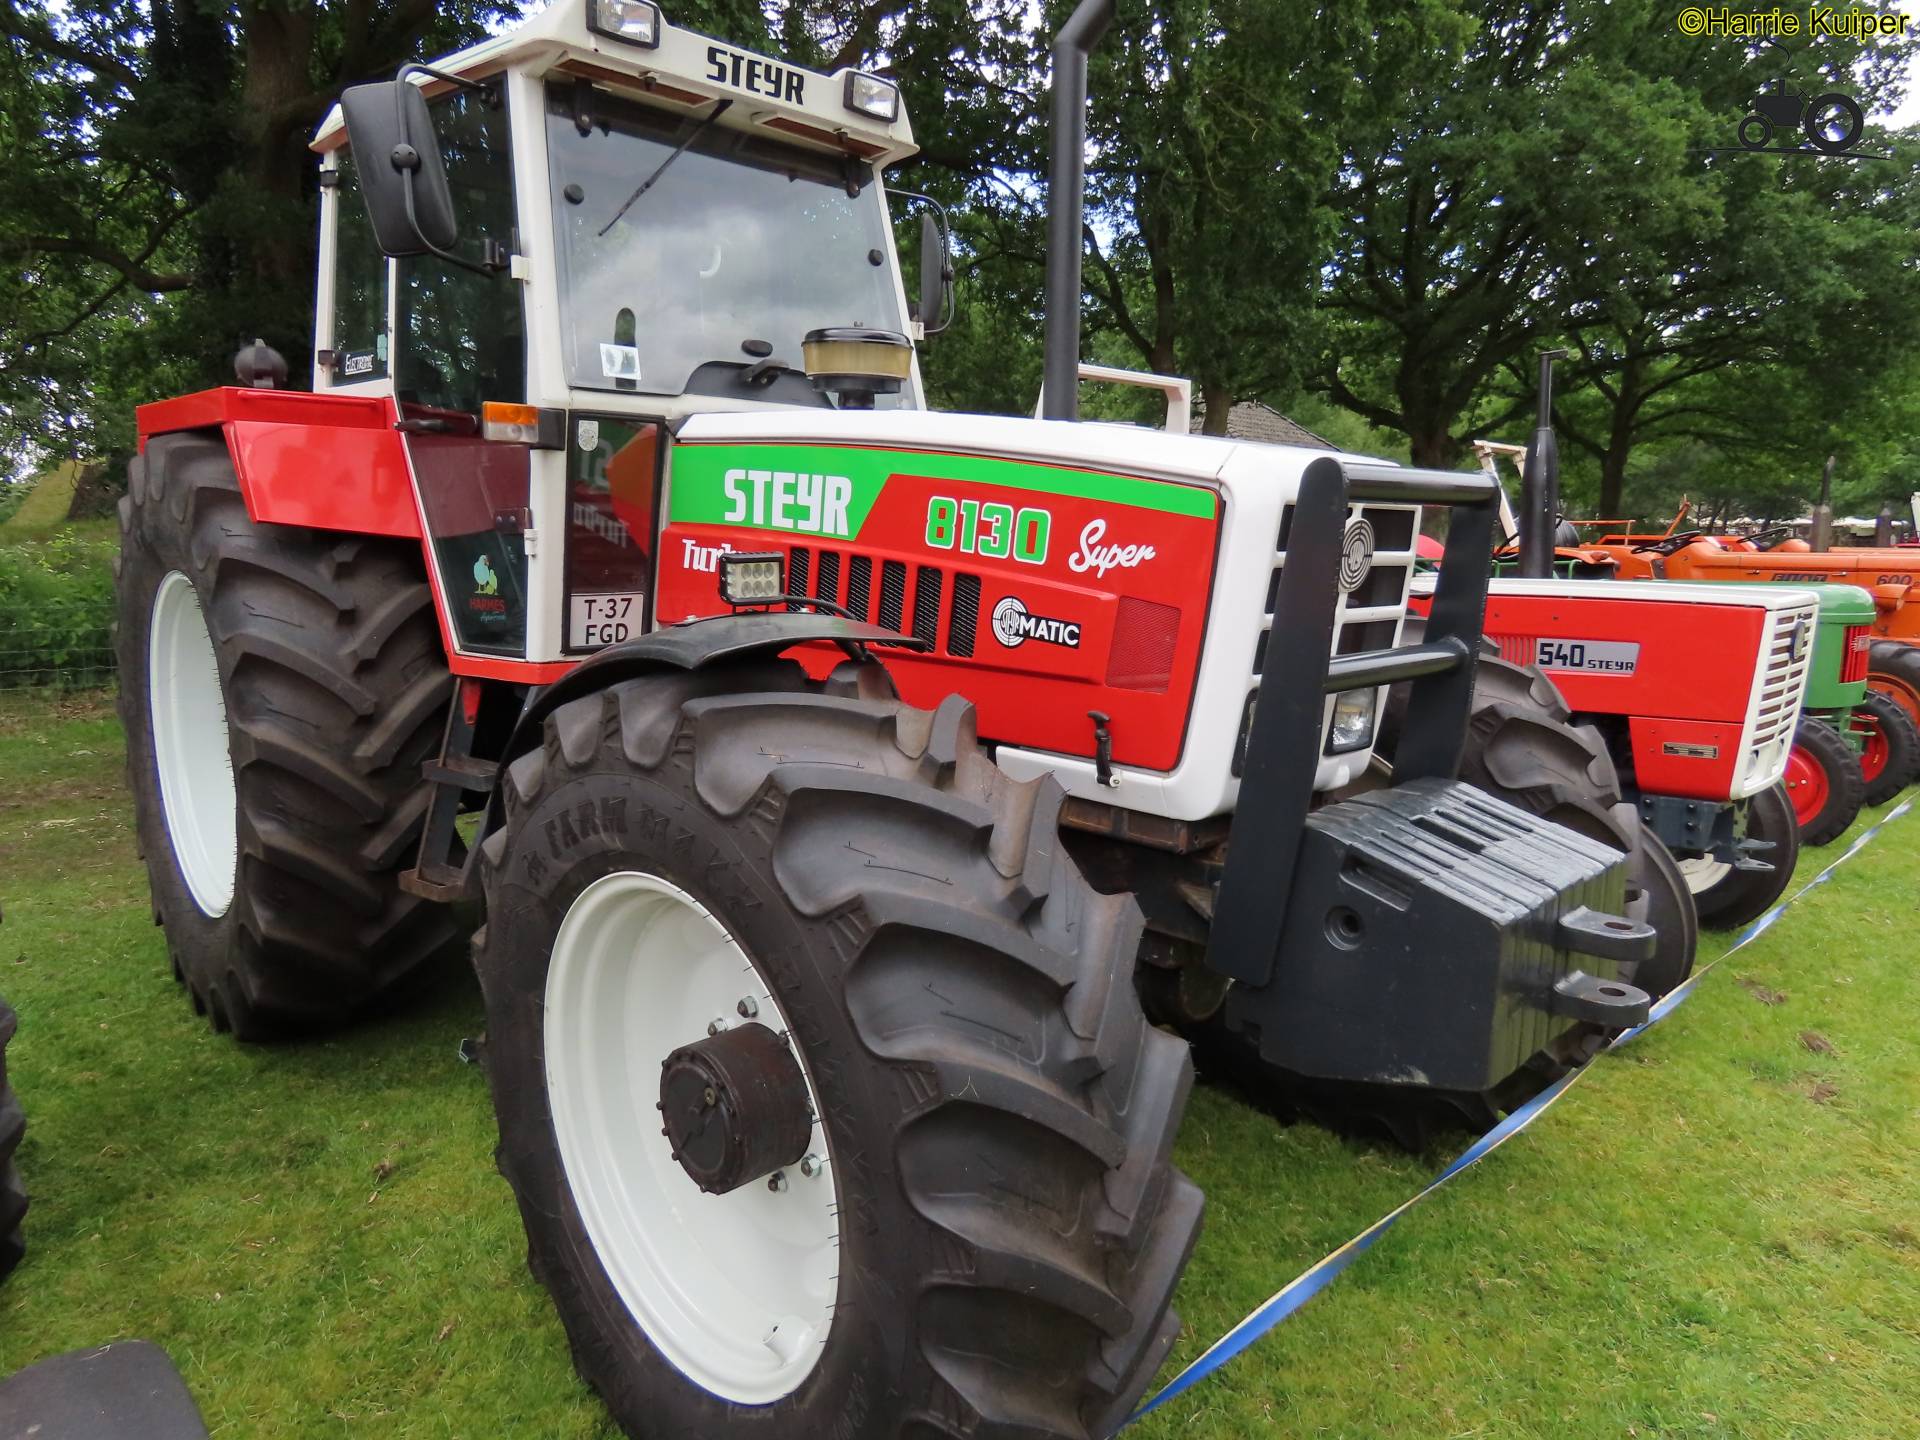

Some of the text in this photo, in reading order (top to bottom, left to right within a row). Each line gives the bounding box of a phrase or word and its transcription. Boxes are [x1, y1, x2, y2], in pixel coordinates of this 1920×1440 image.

[706, 46, 804, 105] STEYR
[724, 469, 852, 536] STEYR
[925, 496, 1156, 578] 8130 Super
[682, 539, 738, 572] Tur
[584, 598, 632, 620] T-37
[585, 623, 628, 644] FGD
[1019, 616, 1079, 645] MATIC
[1539, 643, 1634, 671] 540 STEYR
